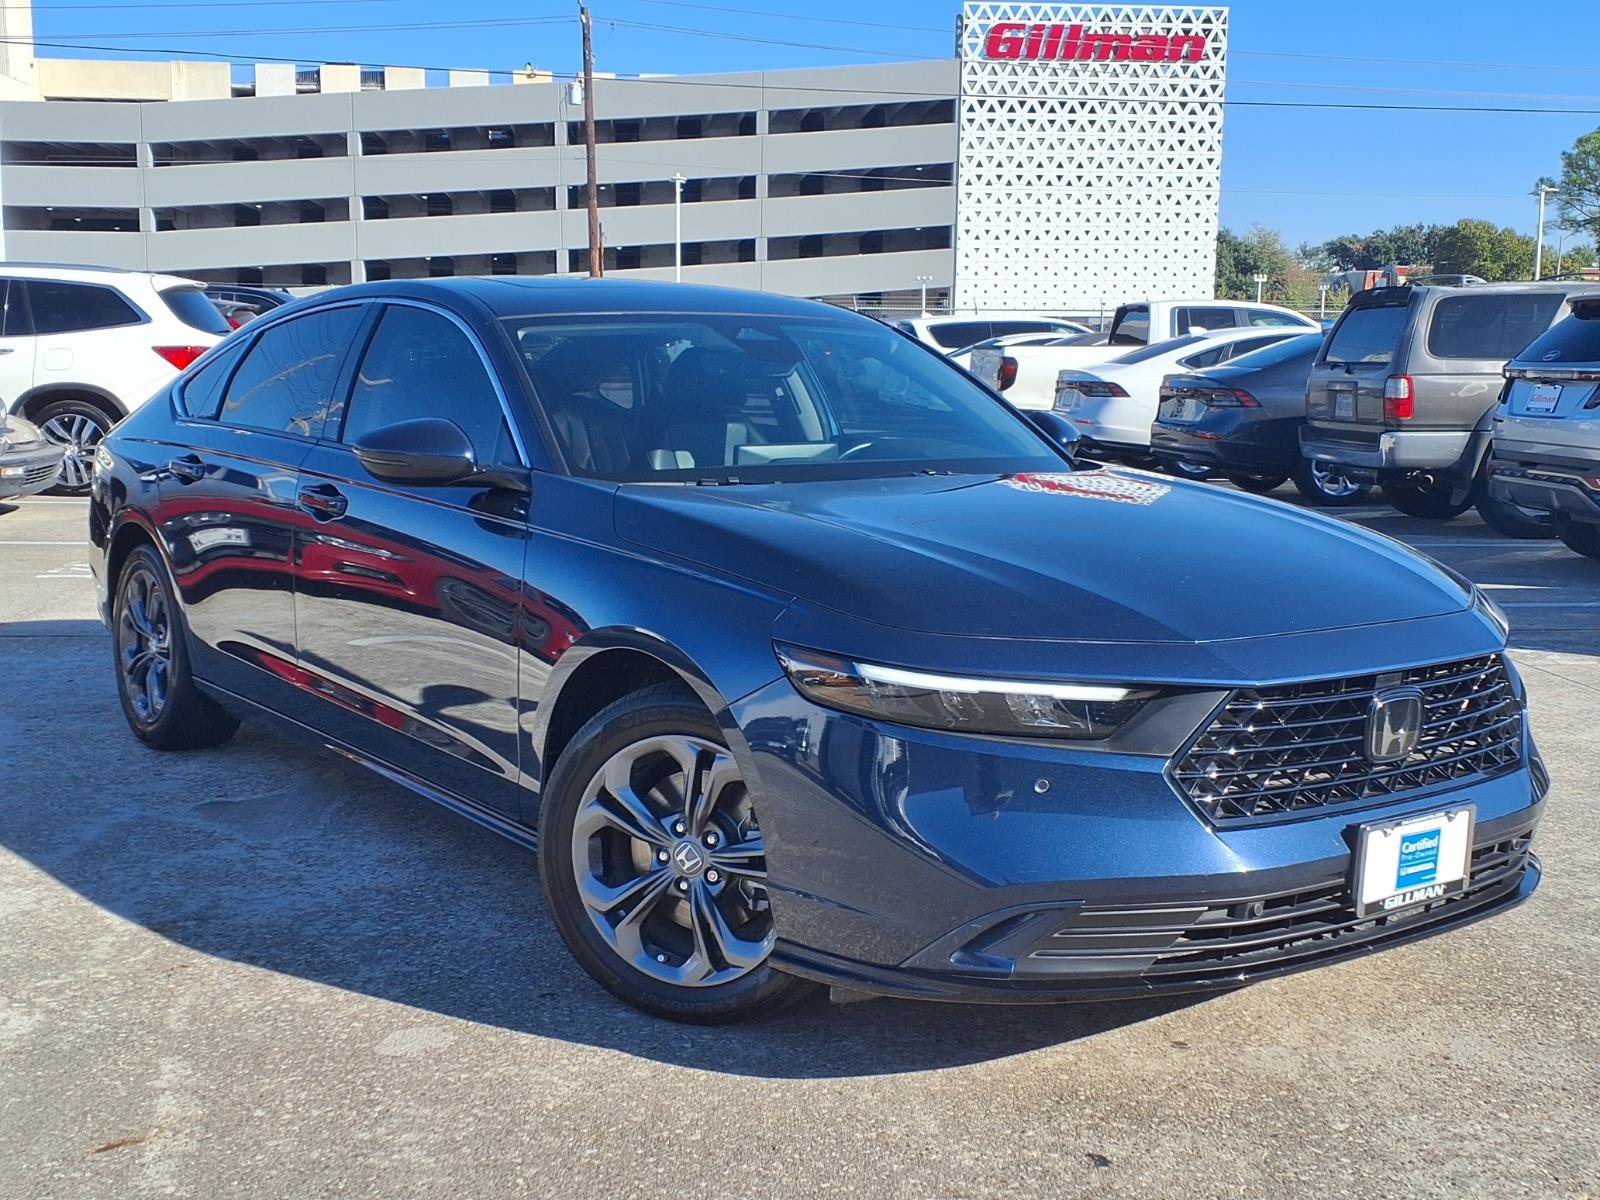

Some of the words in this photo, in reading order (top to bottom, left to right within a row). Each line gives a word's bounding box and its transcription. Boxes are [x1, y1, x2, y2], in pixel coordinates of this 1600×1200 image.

[985, 22, 1208, 63] Gillman
[1402, 835, 1438, 853] Certified
[1384, 884, 1447, 910] GILLMAN
